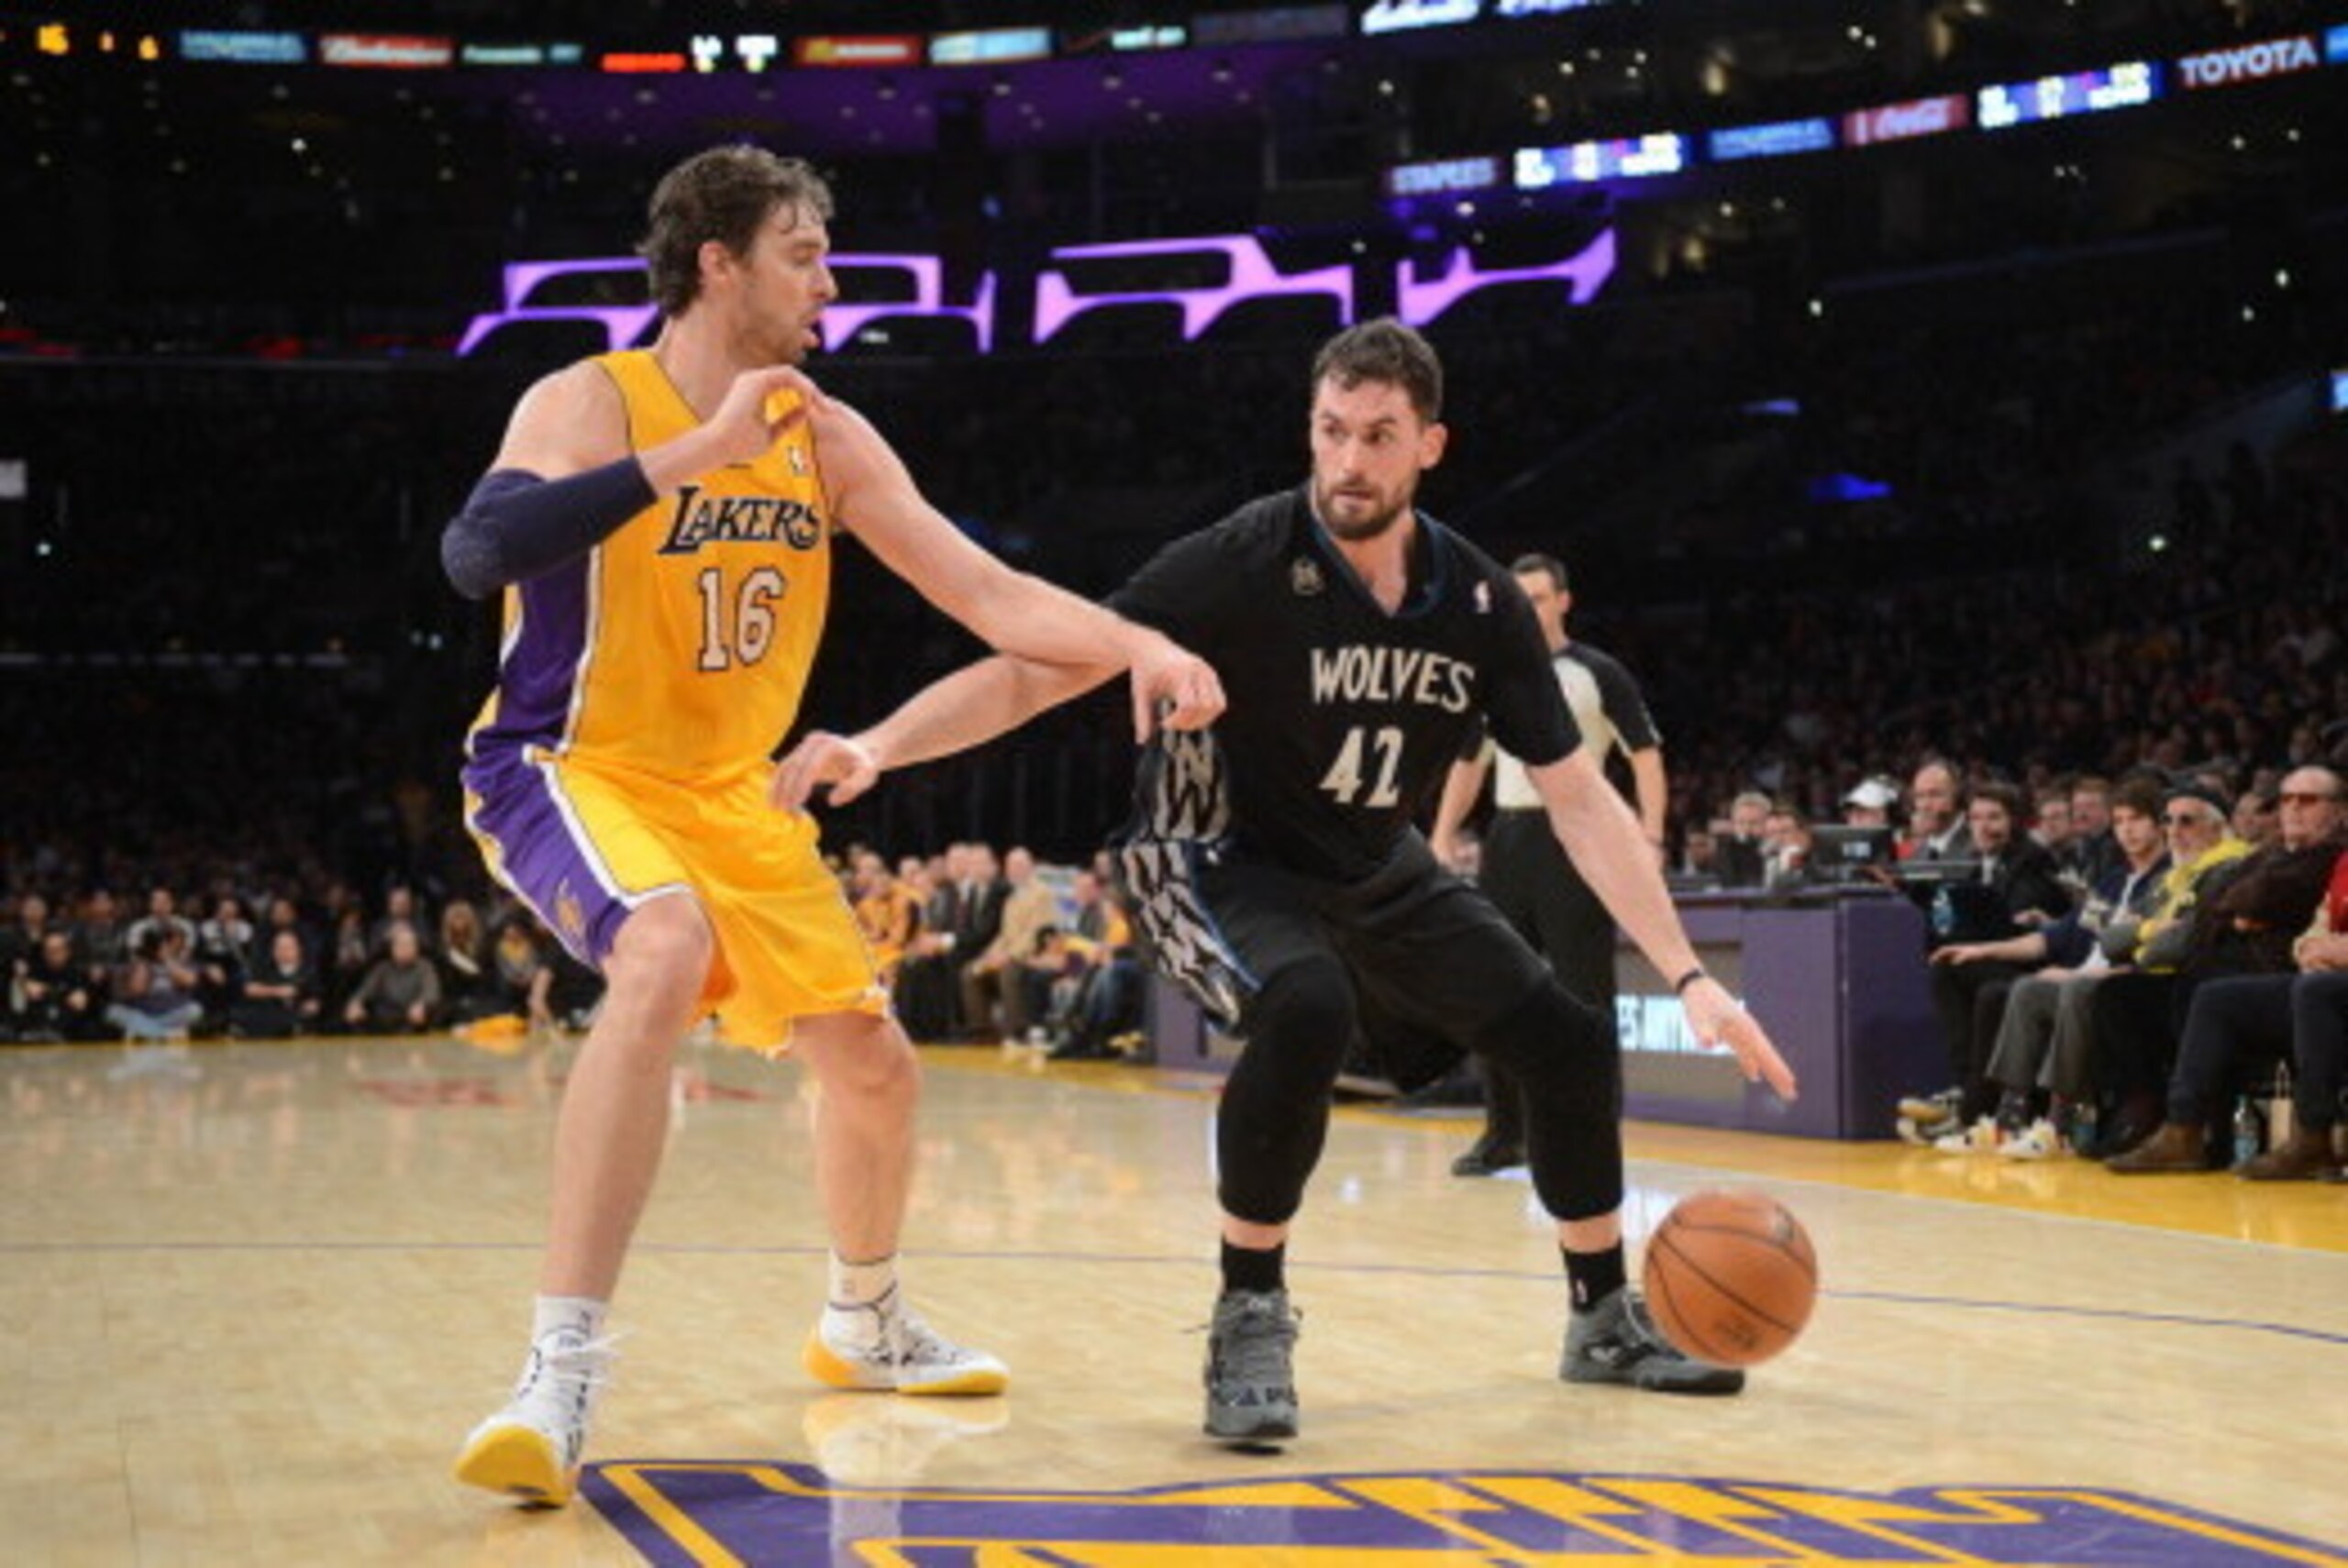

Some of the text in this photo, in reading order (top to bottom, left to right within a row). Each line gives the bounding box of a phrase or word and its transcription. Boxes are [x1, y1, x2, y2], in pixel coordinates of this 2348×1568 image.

[2178, 36, 2319, 87] TOYOTA
[657, 485, 820, 556] LAKERS
[698, 566, 788, 673] 16
[1310, 645, 1475, 713] WOLVES
[1319, 726, 1404, 808] 42
